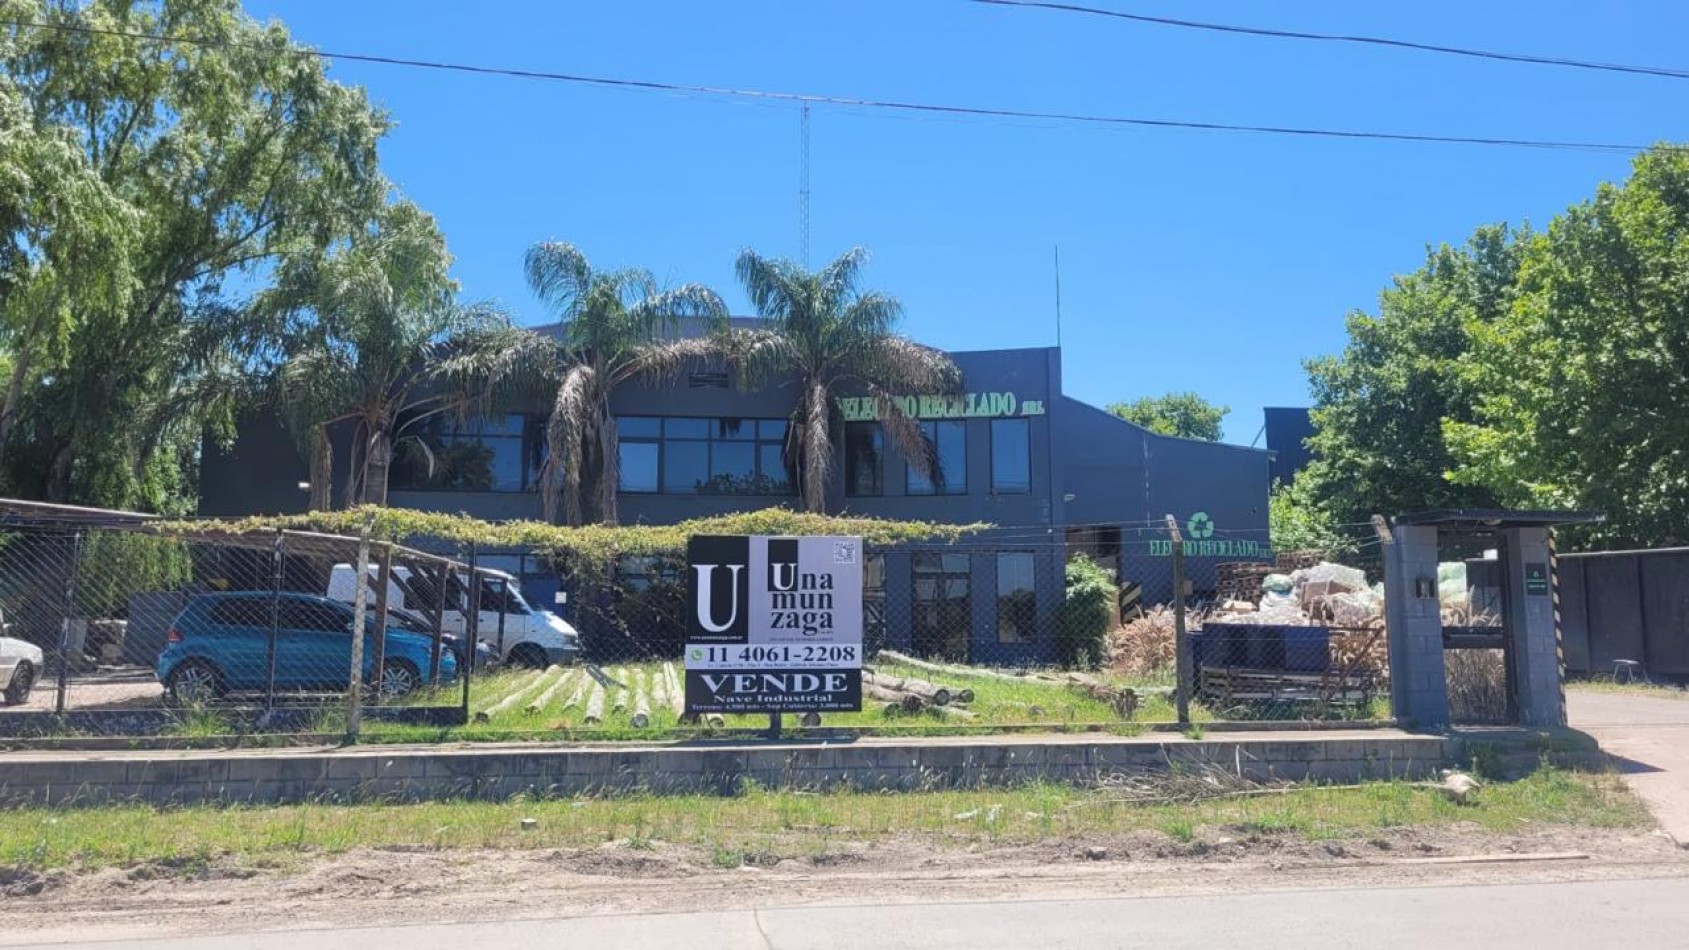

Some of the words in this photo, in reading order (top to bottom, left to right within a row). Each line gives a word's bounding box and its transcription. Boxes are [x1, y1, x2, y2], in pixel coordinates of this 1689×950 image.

[691, 564, 745, 632] U
[771, 592, 834, 609] mun
[770, 612, 834, 636] zaga
[707, 647, 728, 662] 11
[738, 646, 856, 662] 4061-2208
[701, 673, 848, 693] VENDE
[713, 695, 752, 703] Nave
[757, 694, 832, 703] Industrial
